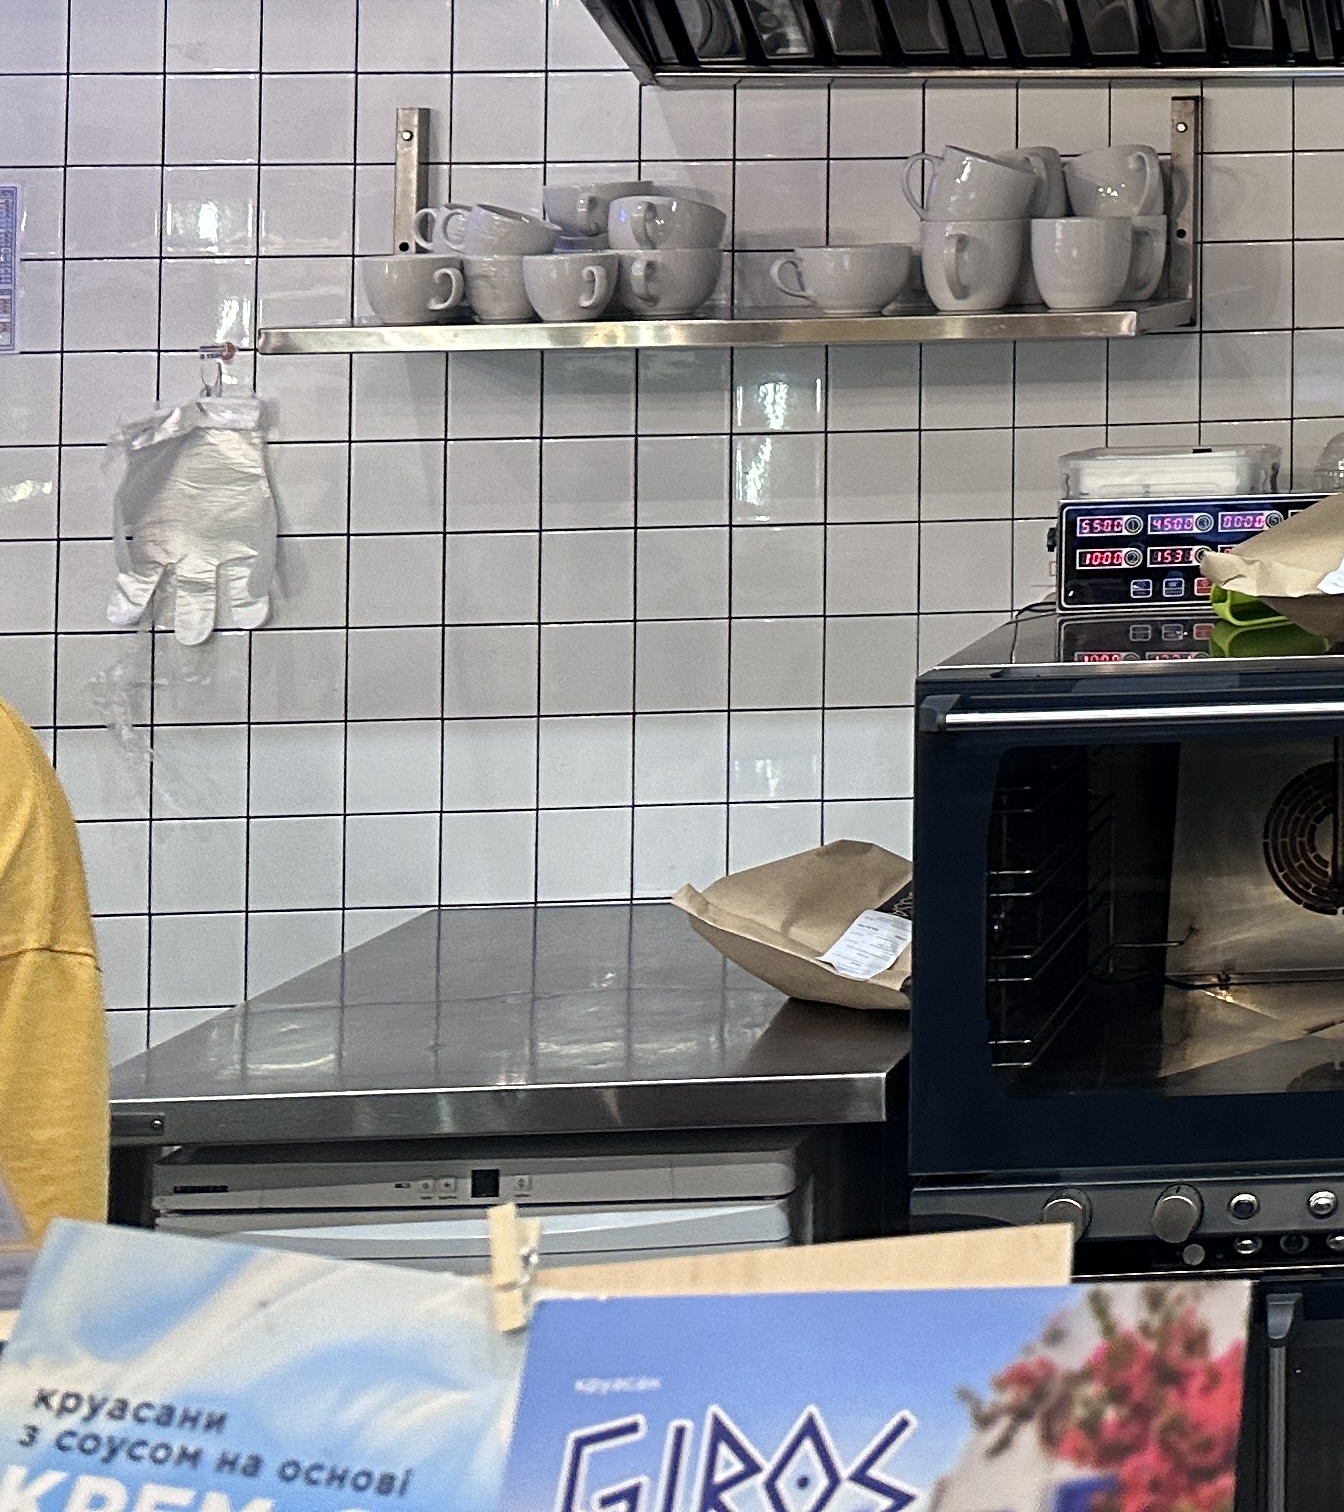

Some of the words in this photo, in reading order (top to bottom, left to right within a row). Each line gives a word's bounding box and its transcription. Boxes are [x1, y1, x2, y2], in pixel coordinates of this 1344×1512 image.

[33, 1387, 229, 1434] круасани
[18, 1424, 40, 1448] з
[54, 1428, 202, 1471] соусом
[214, 1449, 265, 1479] на
[276, 1458, 413, 1498] основі
